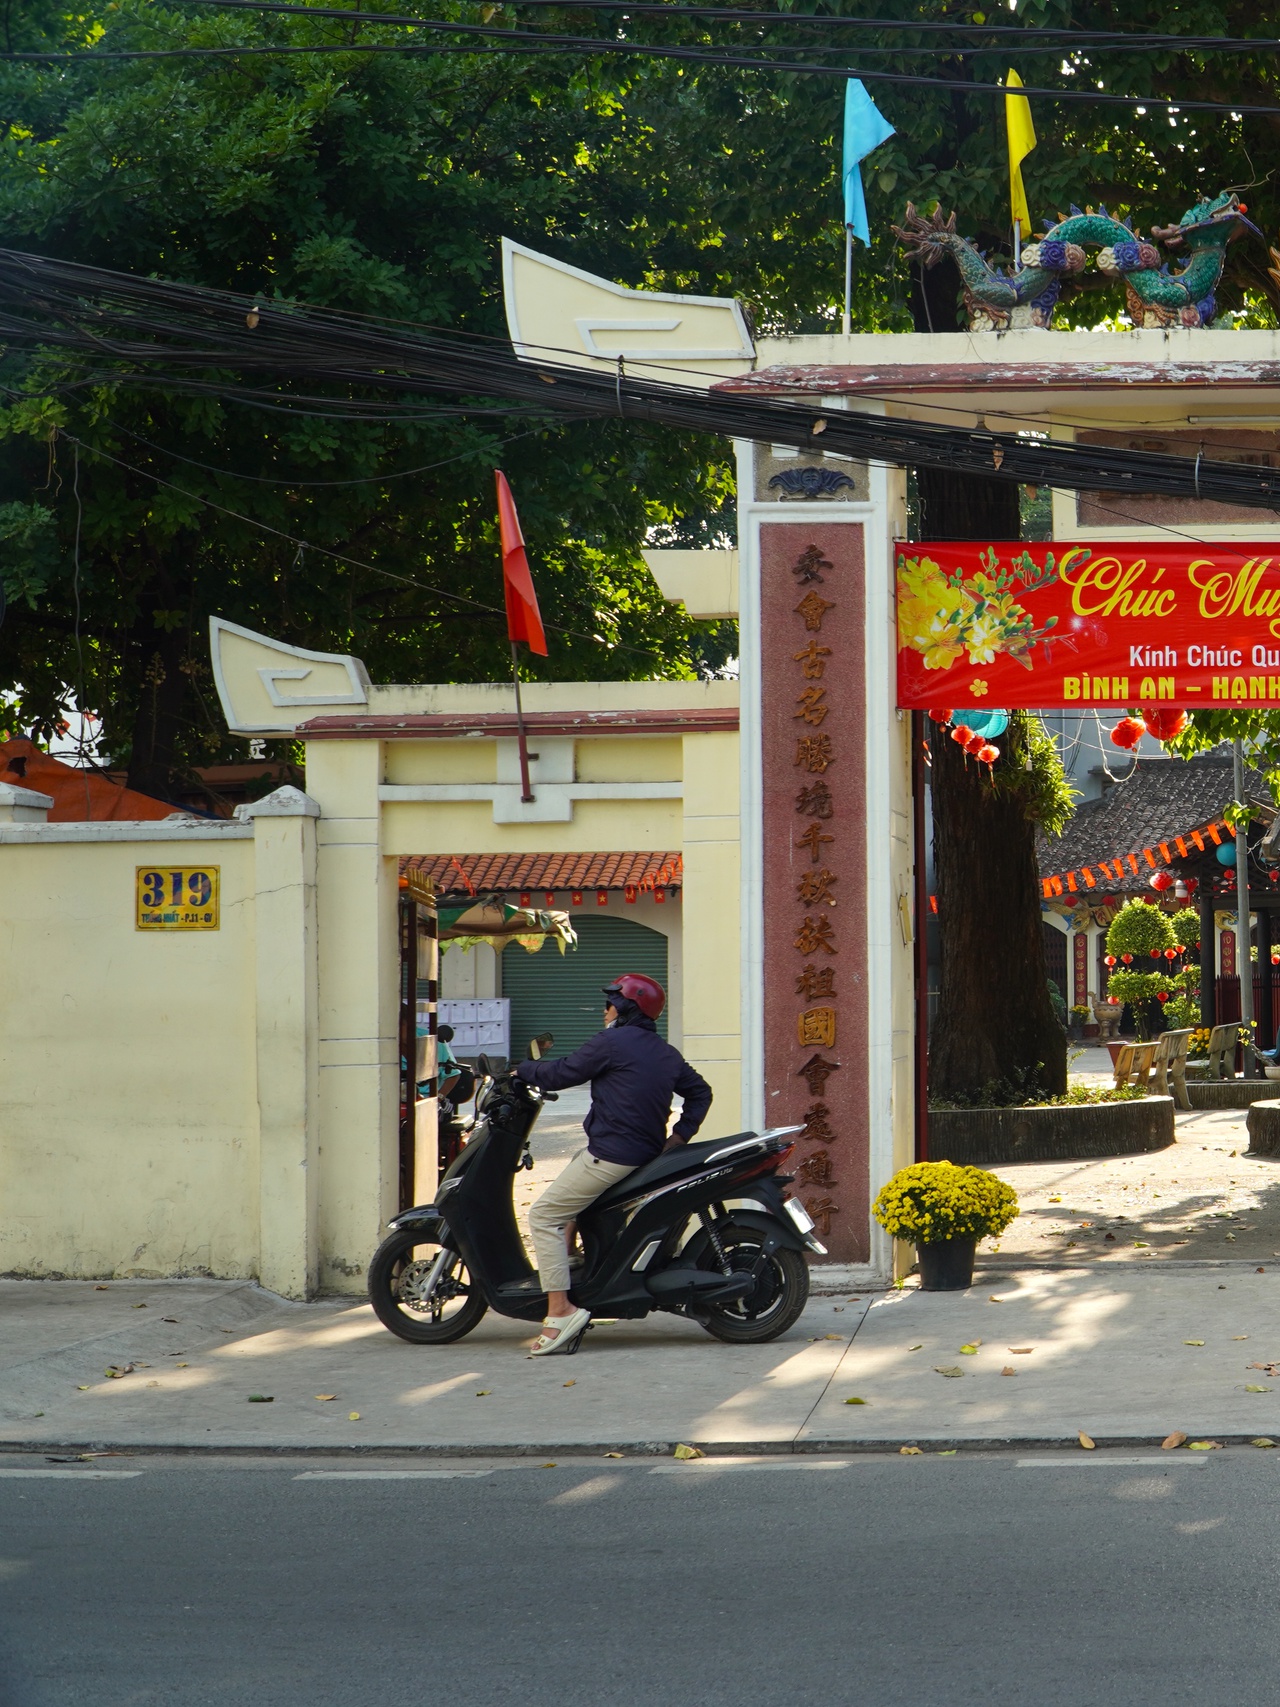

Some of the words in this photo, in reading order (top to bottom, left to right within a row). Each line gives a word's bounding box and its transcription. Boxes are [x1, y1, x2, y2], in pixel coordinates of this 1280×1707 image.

[1059, 549, 1177, 616] Chúc
[1129, 645, 1177, 667] Kính
[1187, 645, 1242, 667] Chúc
[1063, 672, 1129, 699] BÌNH
[1140, 676, 1175, 699] AN
[142, 872, 212, 907] 319
